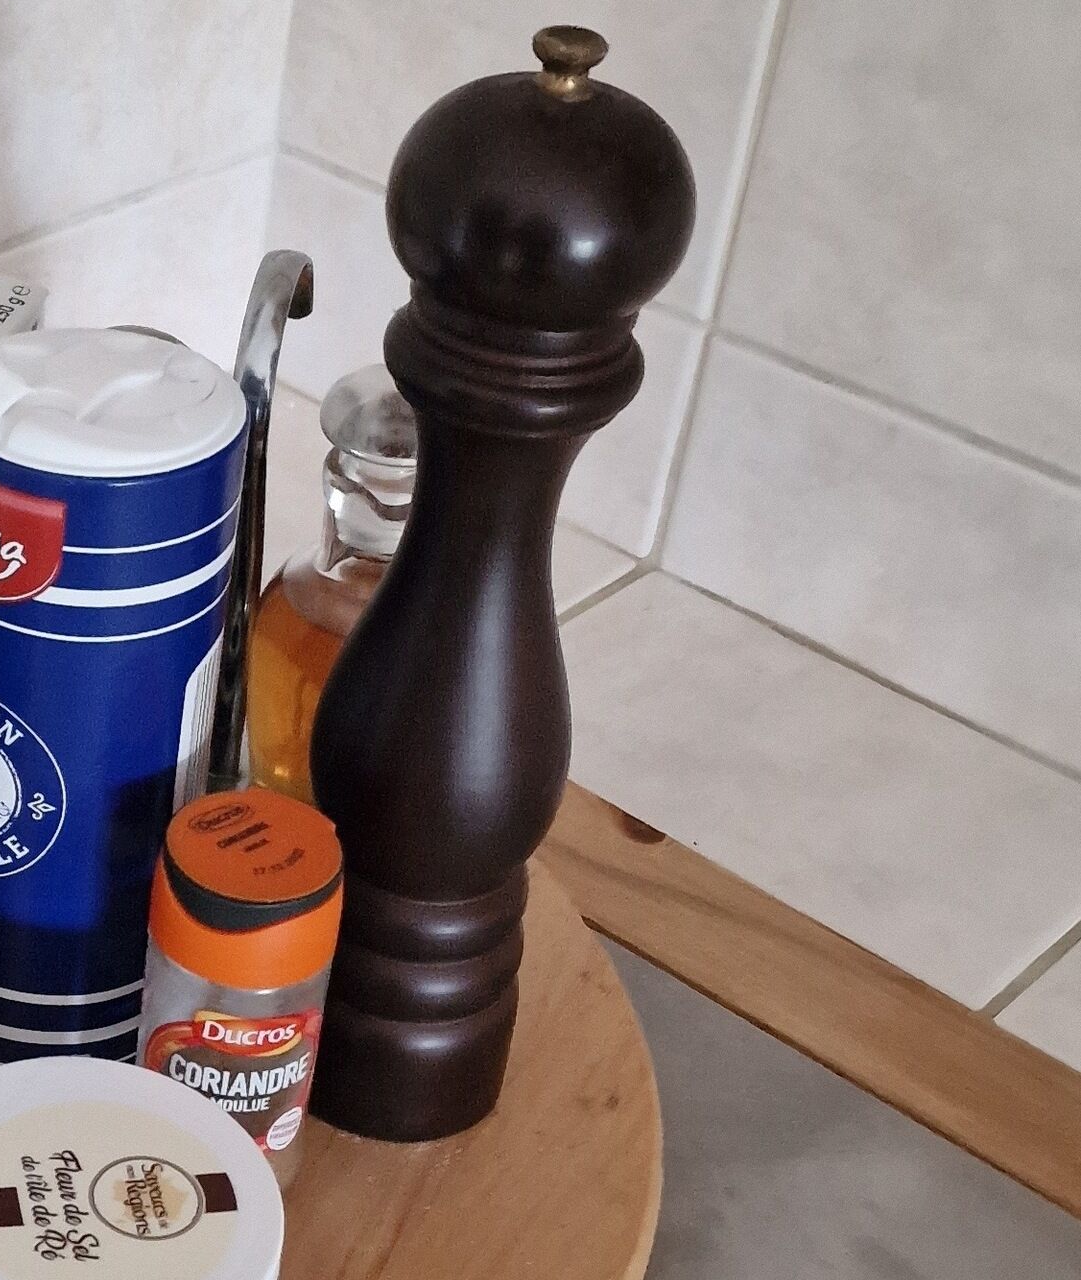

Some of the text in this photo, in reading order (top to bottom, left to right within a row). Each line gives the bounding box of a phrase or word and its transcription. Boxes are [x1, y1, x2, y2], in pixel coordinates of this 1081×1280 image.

[201, 1019, 297, 1048] Ducros
[169, 1051, 311, 1098] CORIANDRE
[21, 1155, 41, 1171] de
[31, 1205, 58, 1228] de
[49, 1150, 100, 1262] Fleur de Sel
[34, 1229, 68, 1262] Ré
